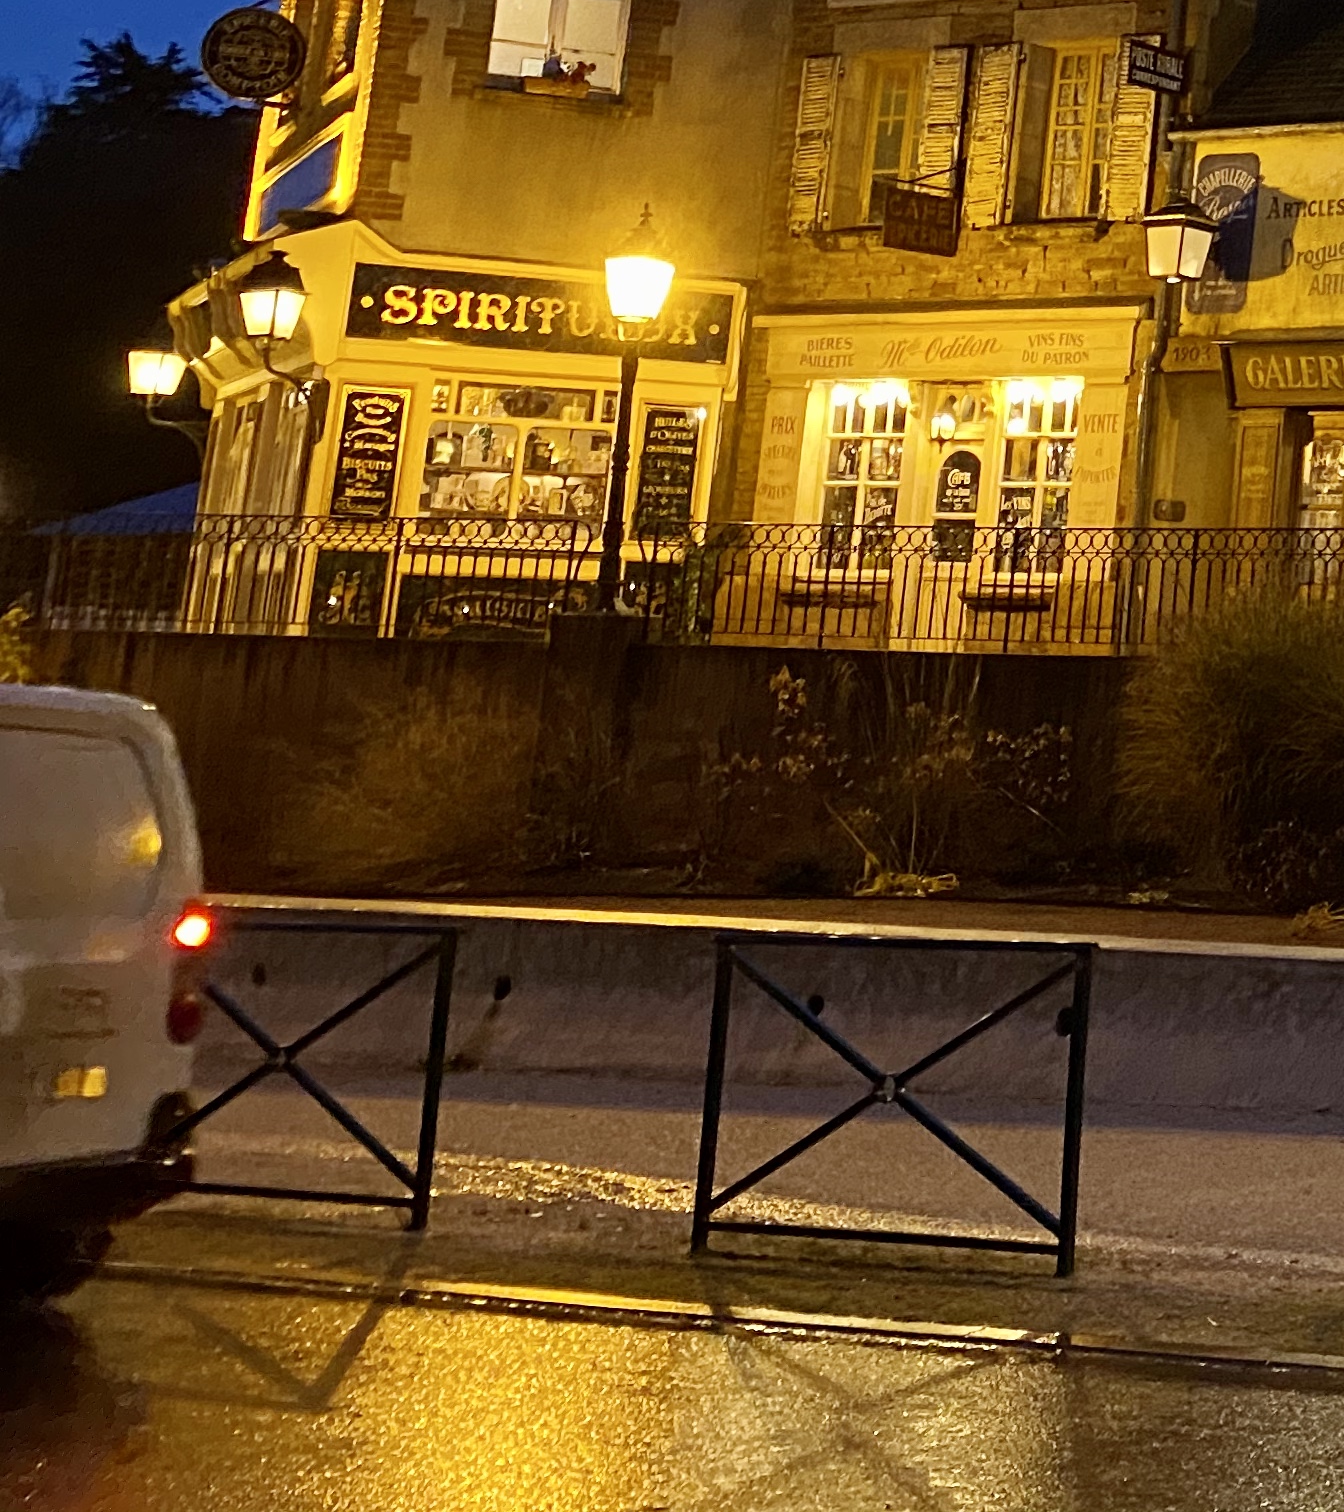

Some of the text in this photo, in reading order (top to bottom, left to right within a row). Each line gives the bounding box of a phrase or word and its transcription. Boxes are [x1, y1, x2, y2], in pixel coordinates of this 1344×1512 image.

[1197, 167, 1257, 197] CHAPELLERIE
[381, 284, 699, 346] SPIRITUX
[925, 334, 1004, 364] Odilon
[1028, 333, 1055, 348] VINS
[1058, 333, 1085, 348] FINS
[1022, 350, 1039, 364] DU
[1043, 349, 1090, 365] PATRON
[770, 415, 798, 435] PRIX
[1083, 413, 1120, 434] VENTE
